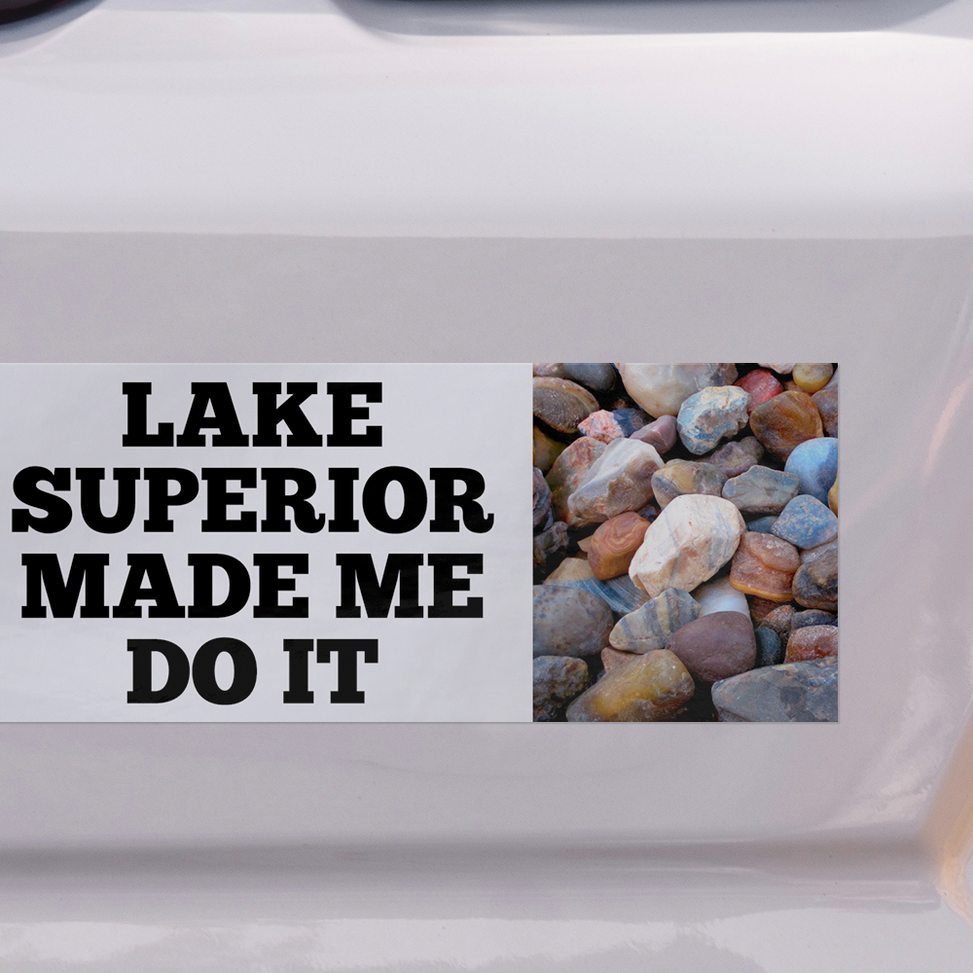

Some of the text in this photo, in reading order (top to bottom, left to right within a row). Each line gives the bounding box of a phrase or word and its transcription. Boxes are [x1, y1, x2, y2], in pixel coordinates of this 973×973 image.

[122, 381, 383, 448] LAKE
[12, 465, 495, 535] SUPERIOR
[21, 553, 484, 619] MADE ME
[127, 637, 379, 706] DO IT
